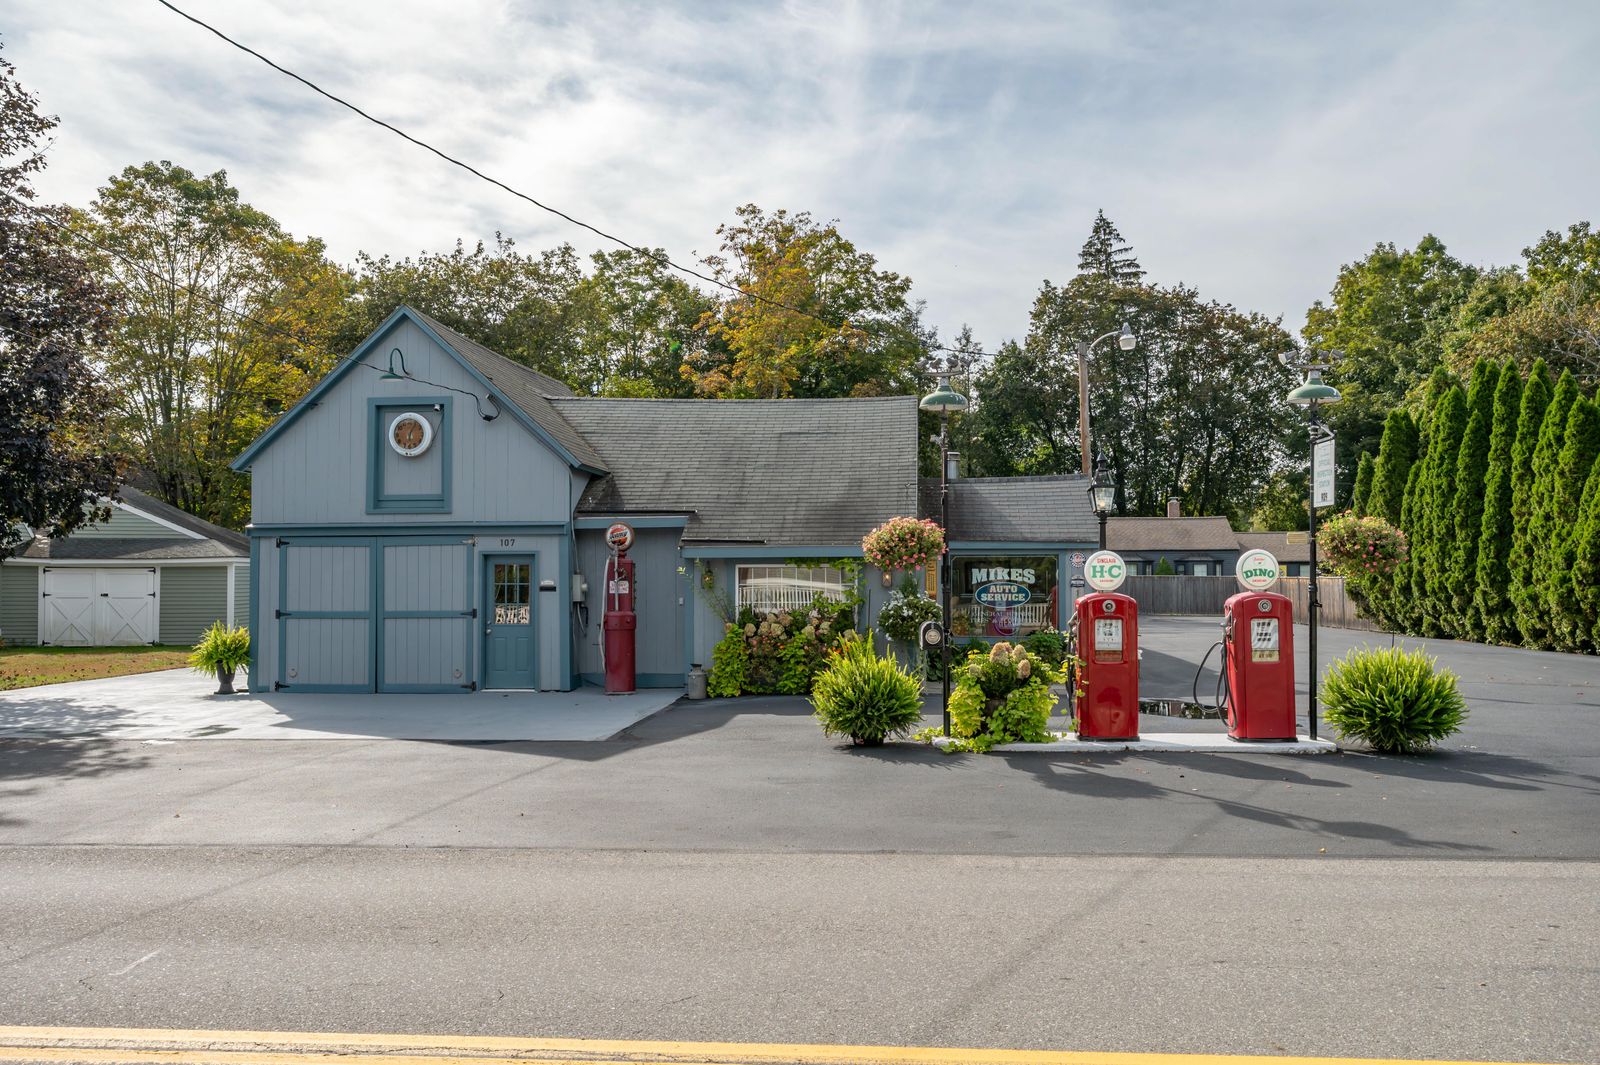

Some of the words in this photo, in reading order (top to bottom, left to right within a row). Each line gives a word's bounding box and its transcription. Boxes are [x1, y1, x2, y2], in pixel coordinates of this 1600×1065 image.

[500, 539, 515, 547] 107
[971, 567, 1036, 584] MIKES
[1243, 568, 1275, 579] DINO
[989, 585, 1018, 593] AUTO
[980, 593, 1026, 601] SERVICE
